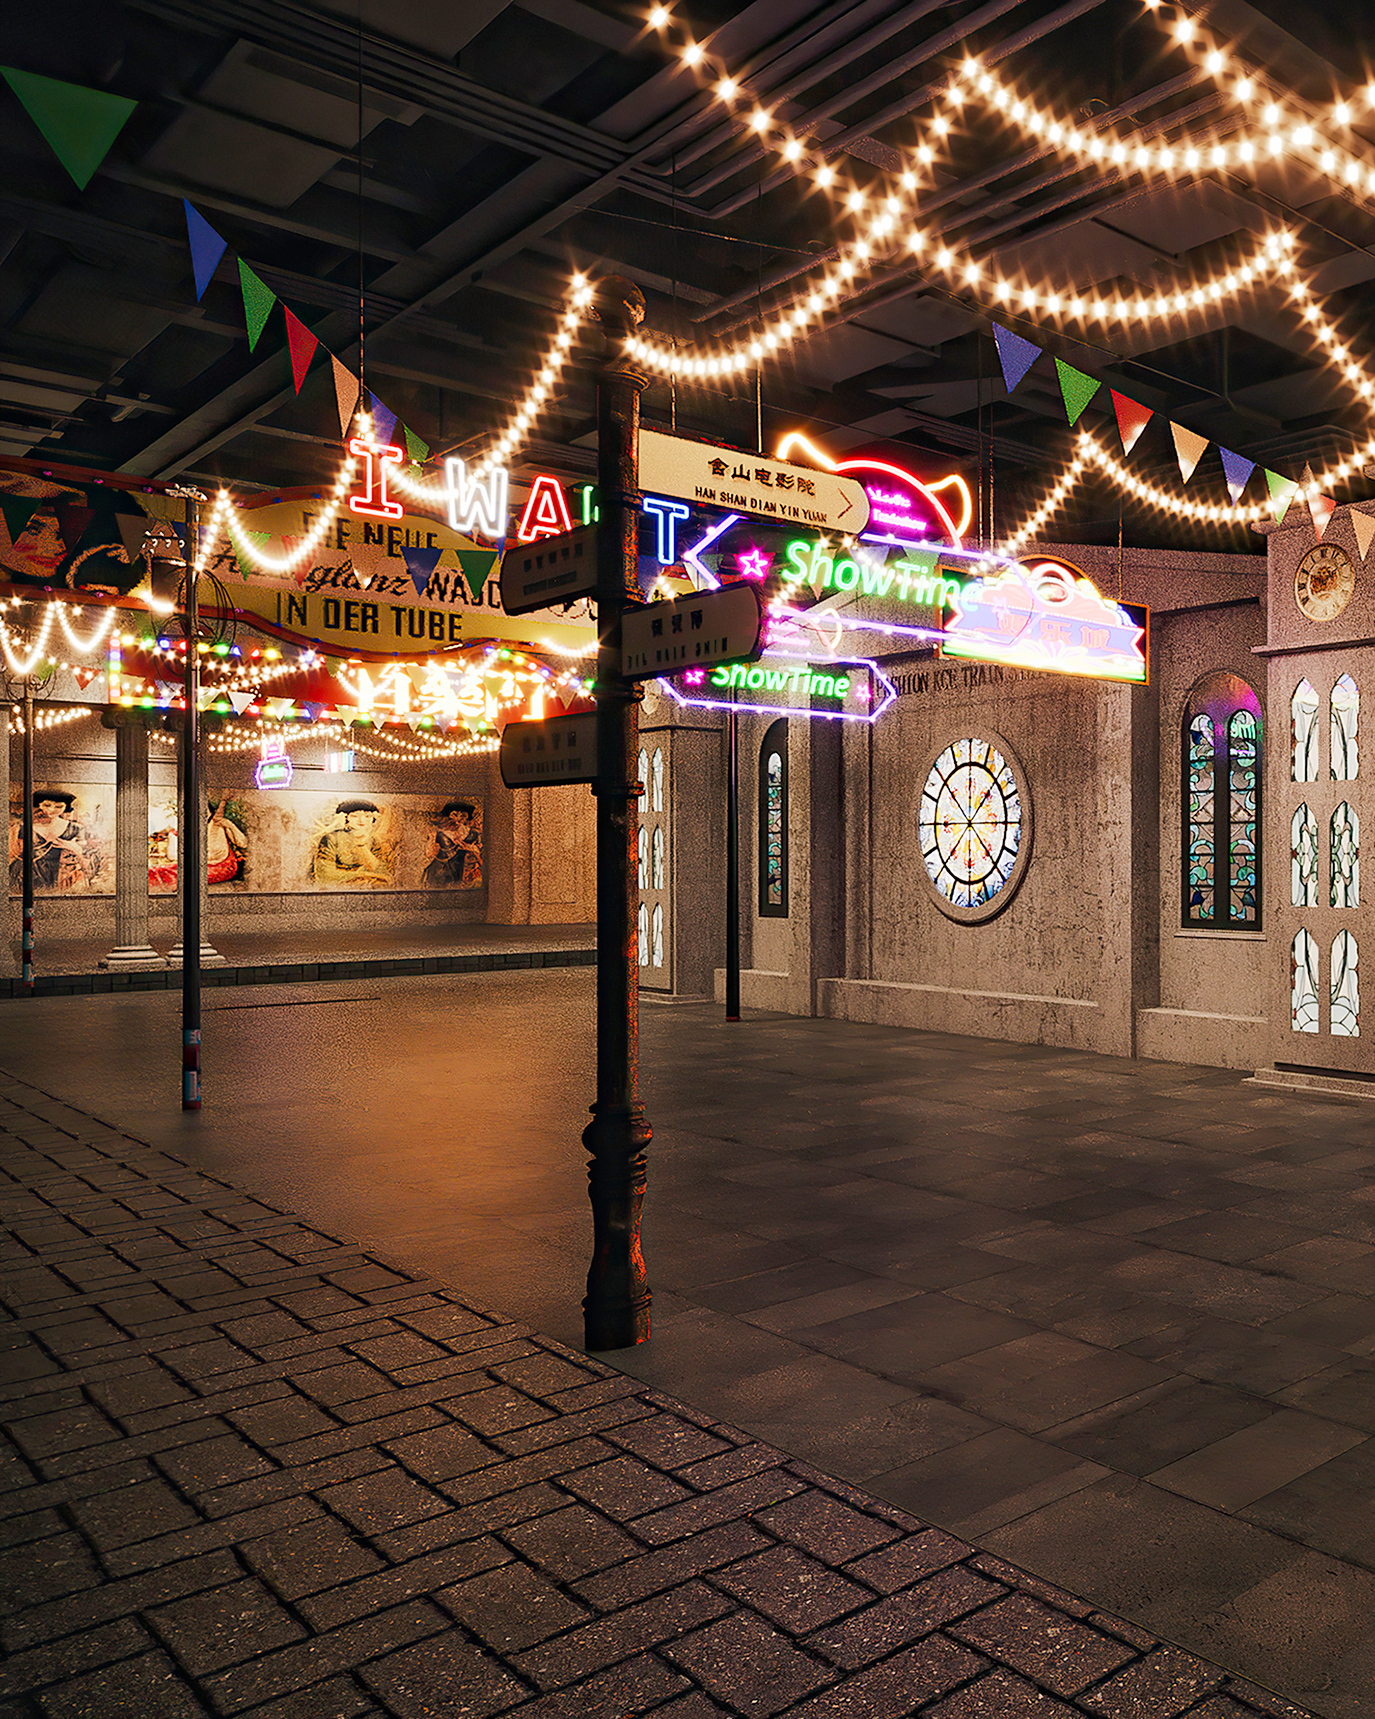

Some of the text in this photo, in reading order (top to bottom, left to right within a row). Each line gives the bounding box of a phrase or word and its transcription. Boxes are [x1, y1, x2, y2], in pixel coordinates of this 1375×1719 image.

[348, 437, 405, 519] I
[695, 485, 828, 523] HAN SHAN DIAN YIN YUAN
[781, 539, 980, 612] ShowTime
[277, 591, 464, 643] IN DER TUBE
